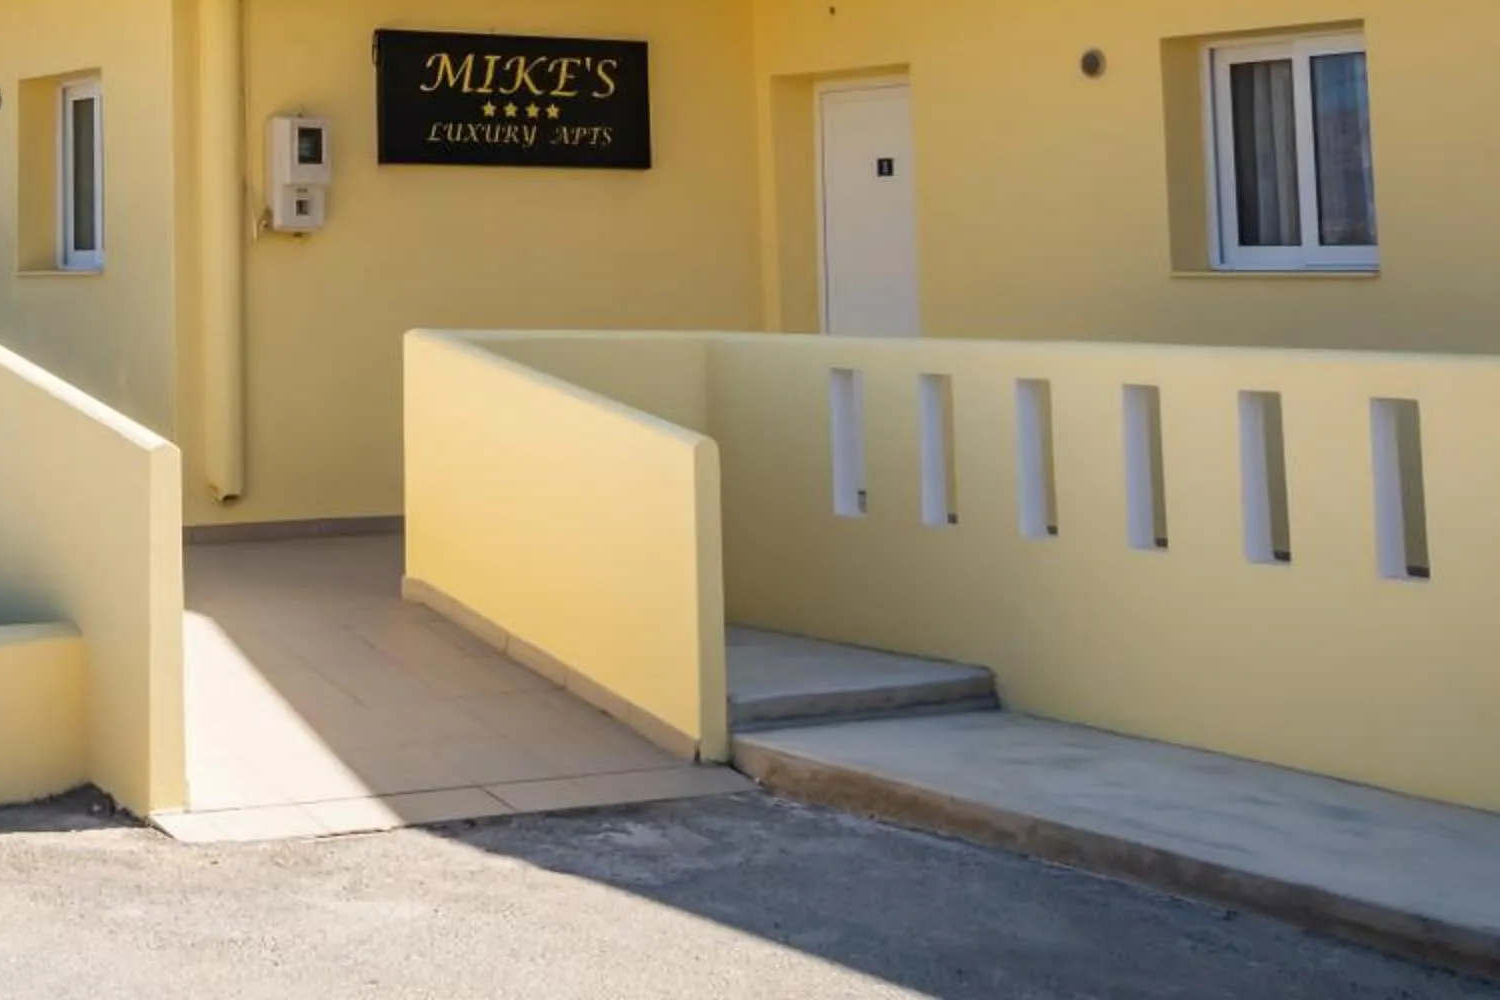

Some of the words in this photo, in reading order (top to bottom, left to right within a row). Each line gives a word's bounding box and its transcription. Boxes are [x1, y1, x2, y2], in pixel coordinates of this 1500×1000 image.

[419, 53, 618, 98] MIKE'S
[427, 121, 537, 149] LUXURY
[549, 126, 613, 146] APTS
